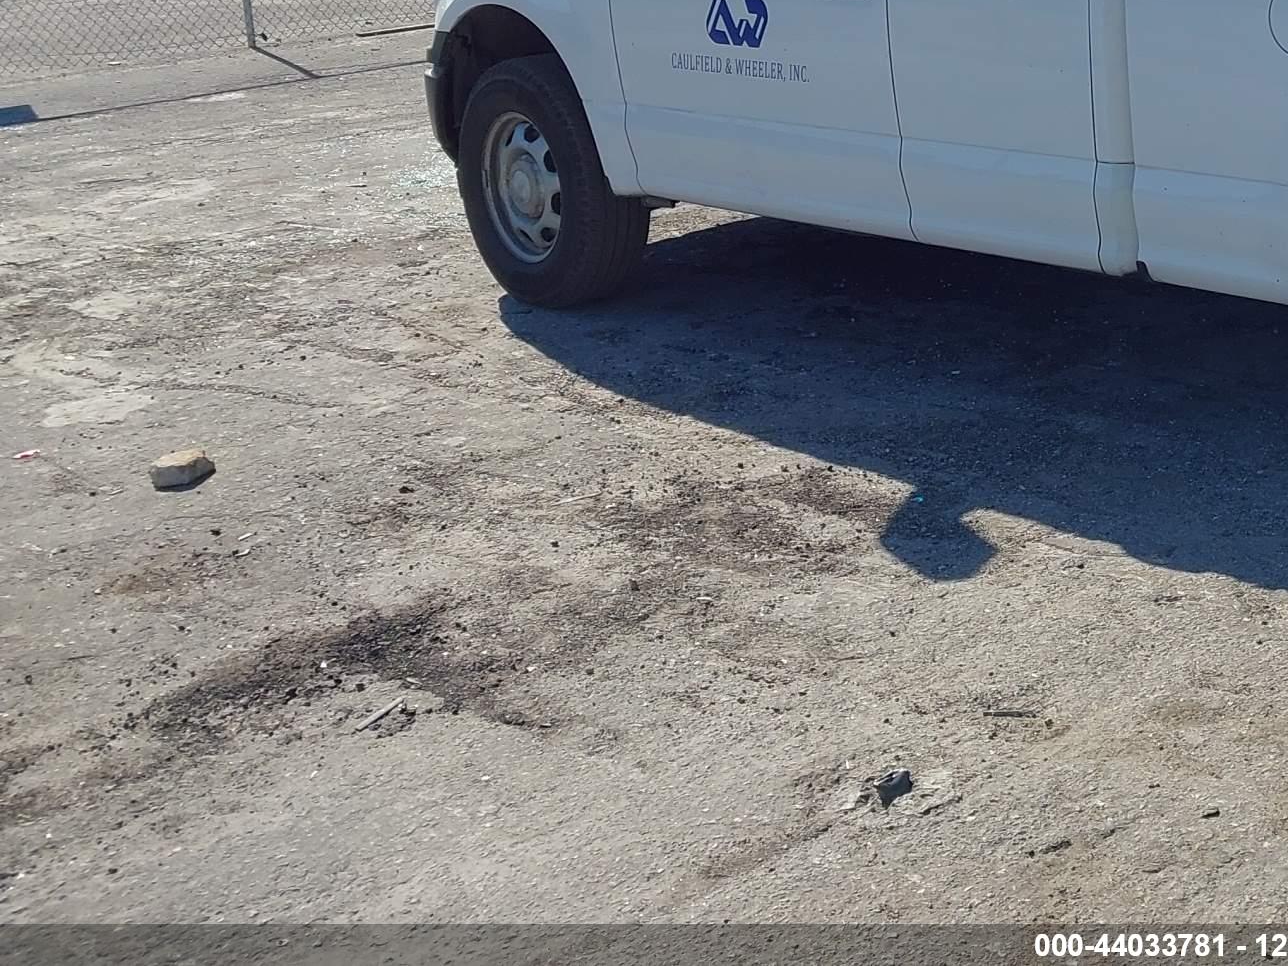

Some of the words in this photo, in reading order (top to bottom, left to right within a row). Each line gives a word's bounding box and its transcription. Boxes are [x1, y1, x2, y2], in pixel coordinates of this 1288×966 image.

[671, 52, 722, 74] CAULFIELD
[725, 57, 732, 75] &
[735, 58, 786, 82] WHEELER,
[789, 64, 810, 83] INC.
